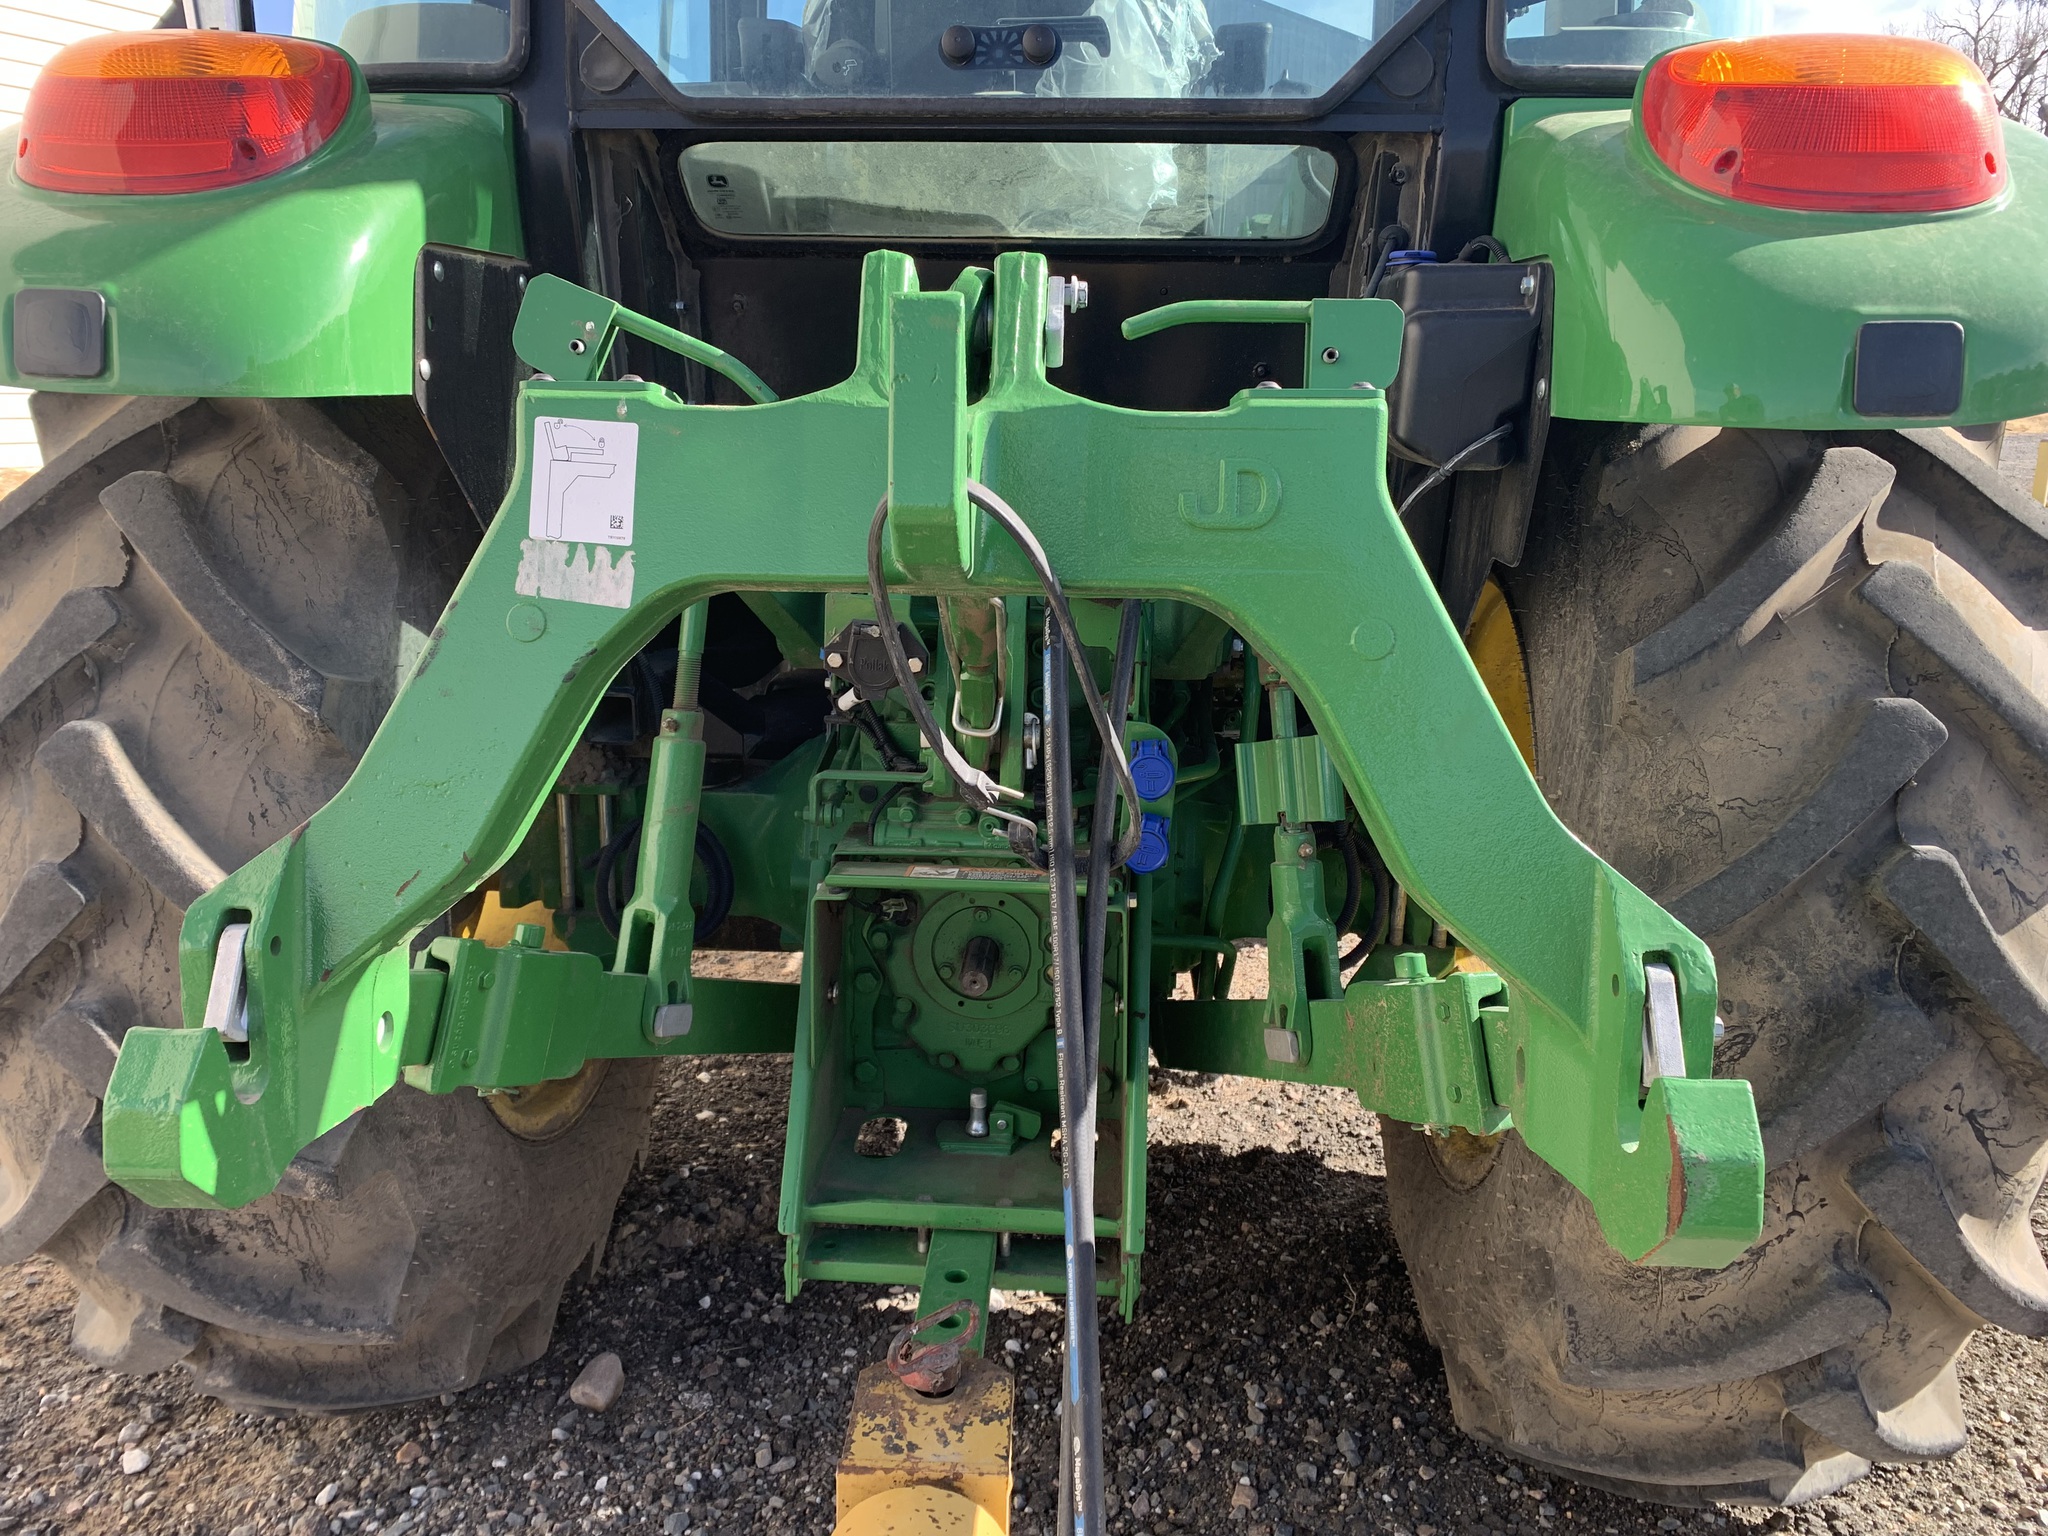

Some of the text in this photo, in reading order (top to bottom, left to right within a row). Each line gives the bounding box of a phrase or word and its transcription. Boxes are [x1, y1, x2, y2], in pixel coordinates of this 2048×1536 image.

[1178, 458, 1282, 531] JD
[859, 656, 889, 672] Pollak
[1059, 1080, 1067, 1118] Resistant
[1062, 1146, 1070, 1179] 2G-11C
